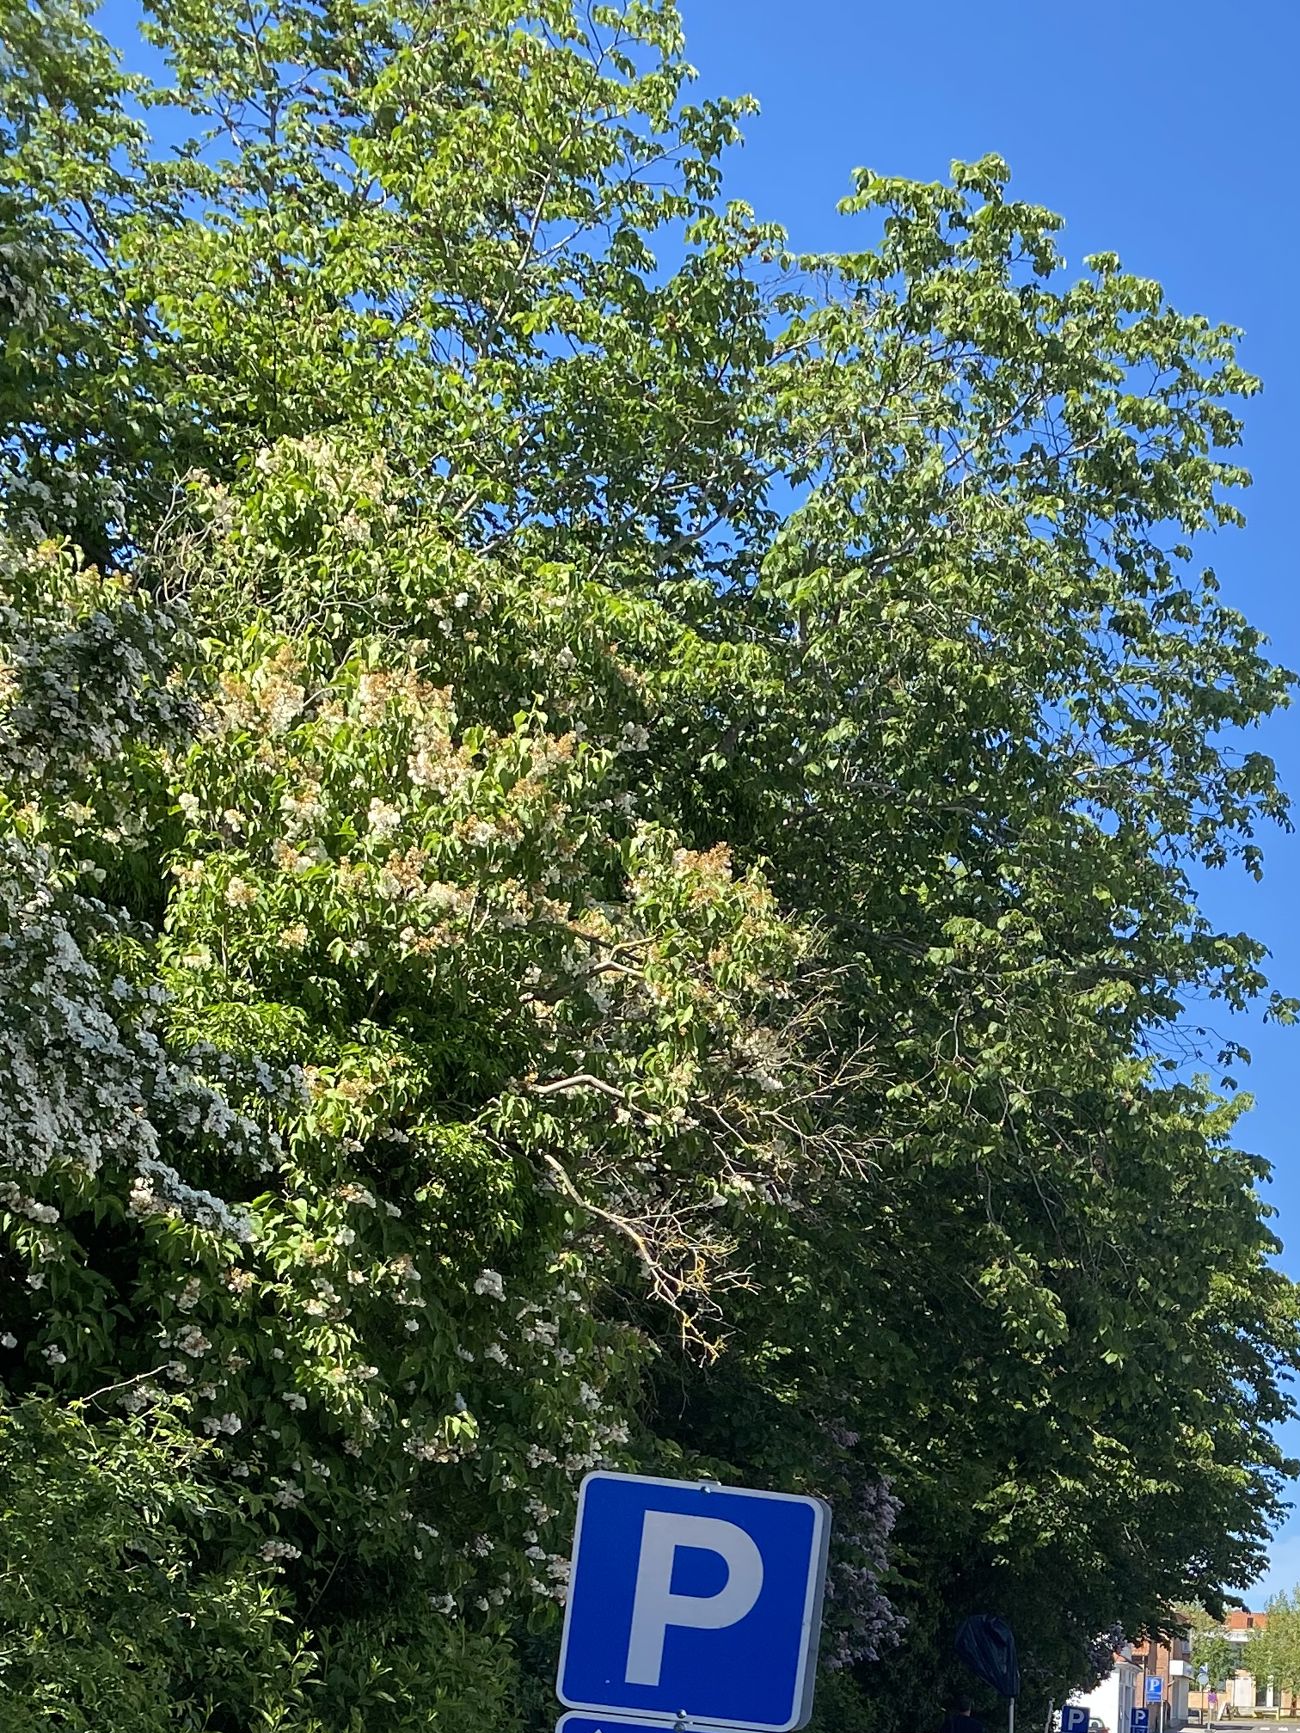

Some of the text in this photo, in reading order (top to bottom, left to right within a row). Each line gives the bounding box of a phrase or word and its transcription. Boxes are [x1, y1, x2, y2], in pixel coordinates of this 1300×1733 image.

[624, 1509, 764, 1686] P
[1150, 1679, 1160, 1691] P
[1068, 1709, 1084, 1730] P
[1135, 1710, 1146, 1724] P
